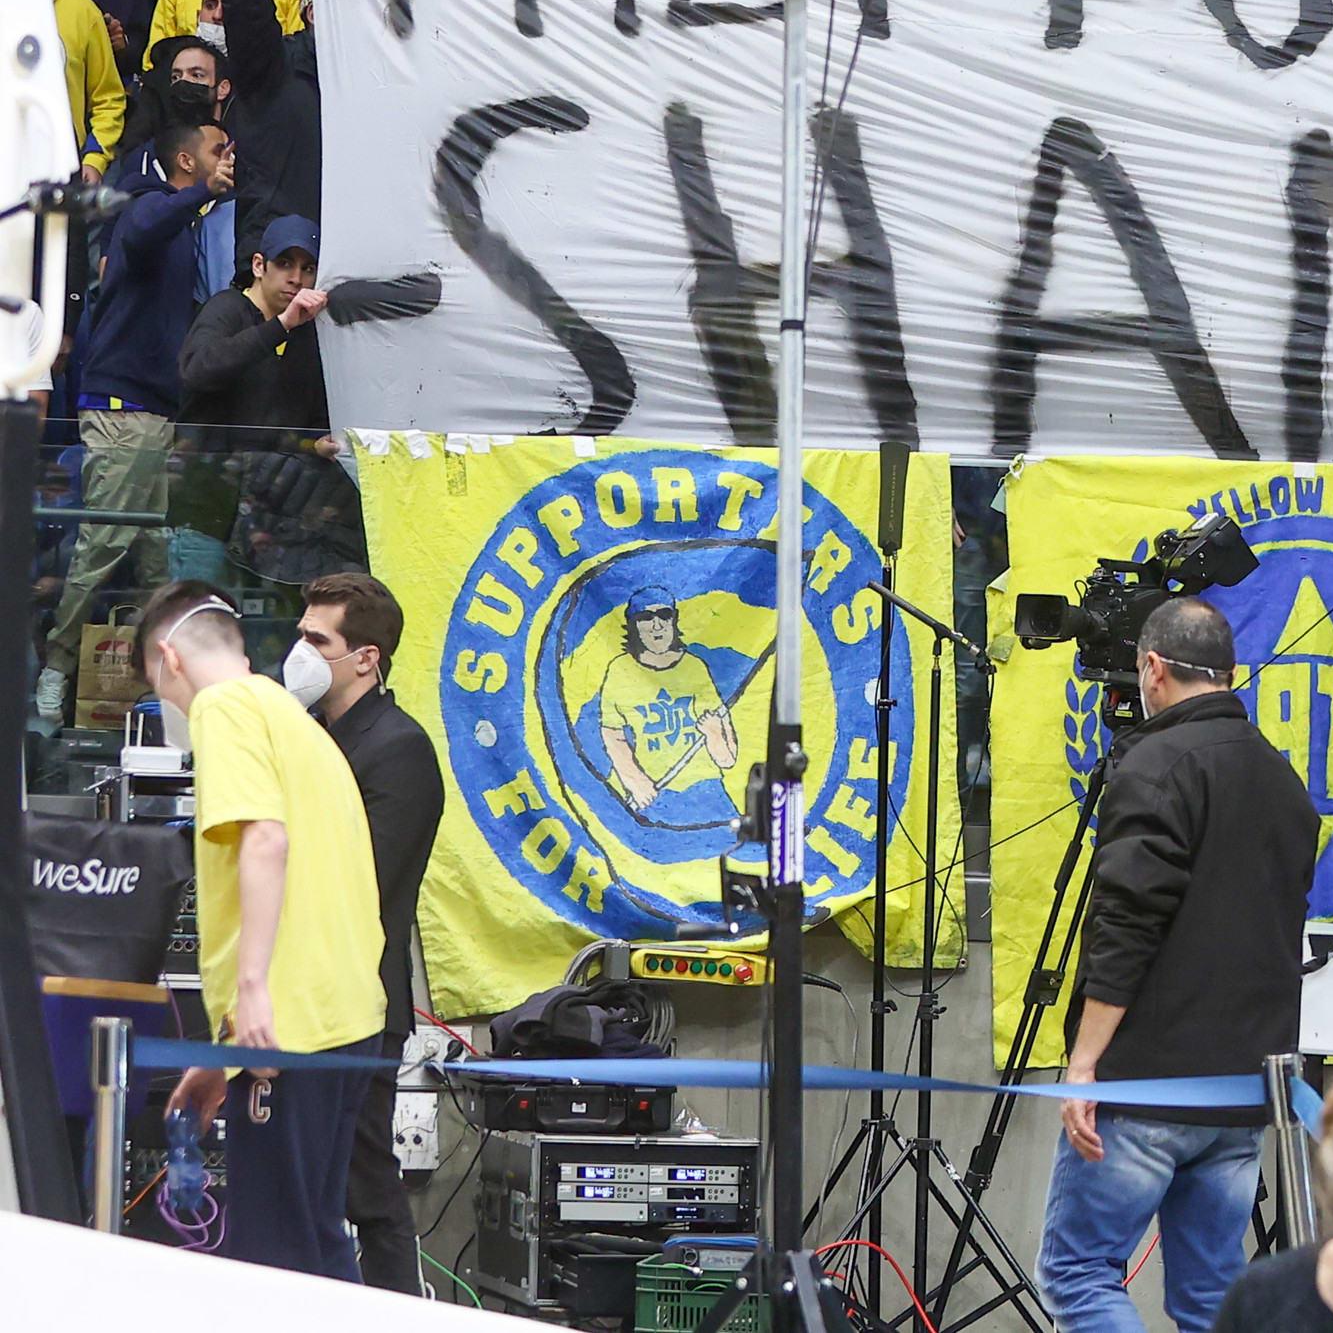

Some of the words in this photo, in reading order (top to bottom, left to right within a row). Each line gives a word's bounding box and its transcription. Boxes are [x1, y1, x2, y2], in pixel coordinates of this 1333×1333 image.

[1186, 475, 1325, 526] YELLOW
[482, 769, 606, 915] FOR
[32, 857, 142, 895] weSure
[247, 1077, 273, 1125] C
